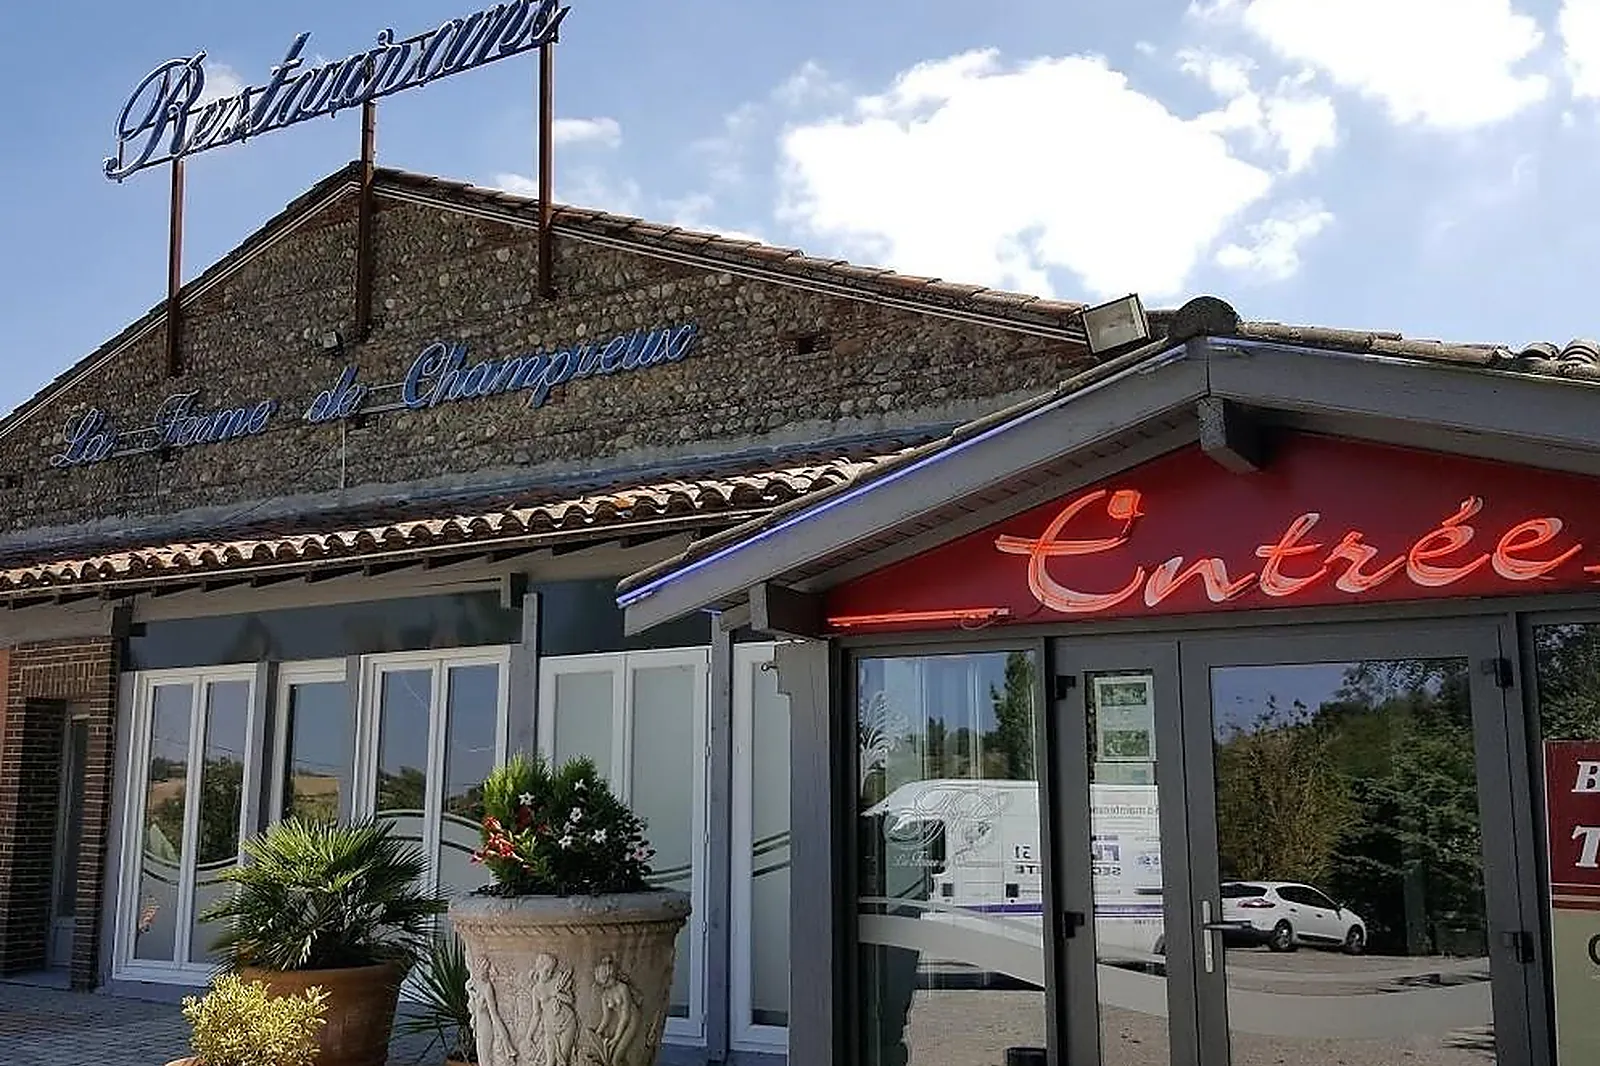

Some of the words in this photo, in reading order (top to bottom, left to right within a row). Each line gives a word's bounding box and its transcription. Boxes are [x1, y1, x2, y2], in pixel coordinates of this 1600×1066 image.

[103, 0, 571, 183] Restaurant
[302, 366, 368, 424] de
[995, 488, 1582, 613] Entrée
